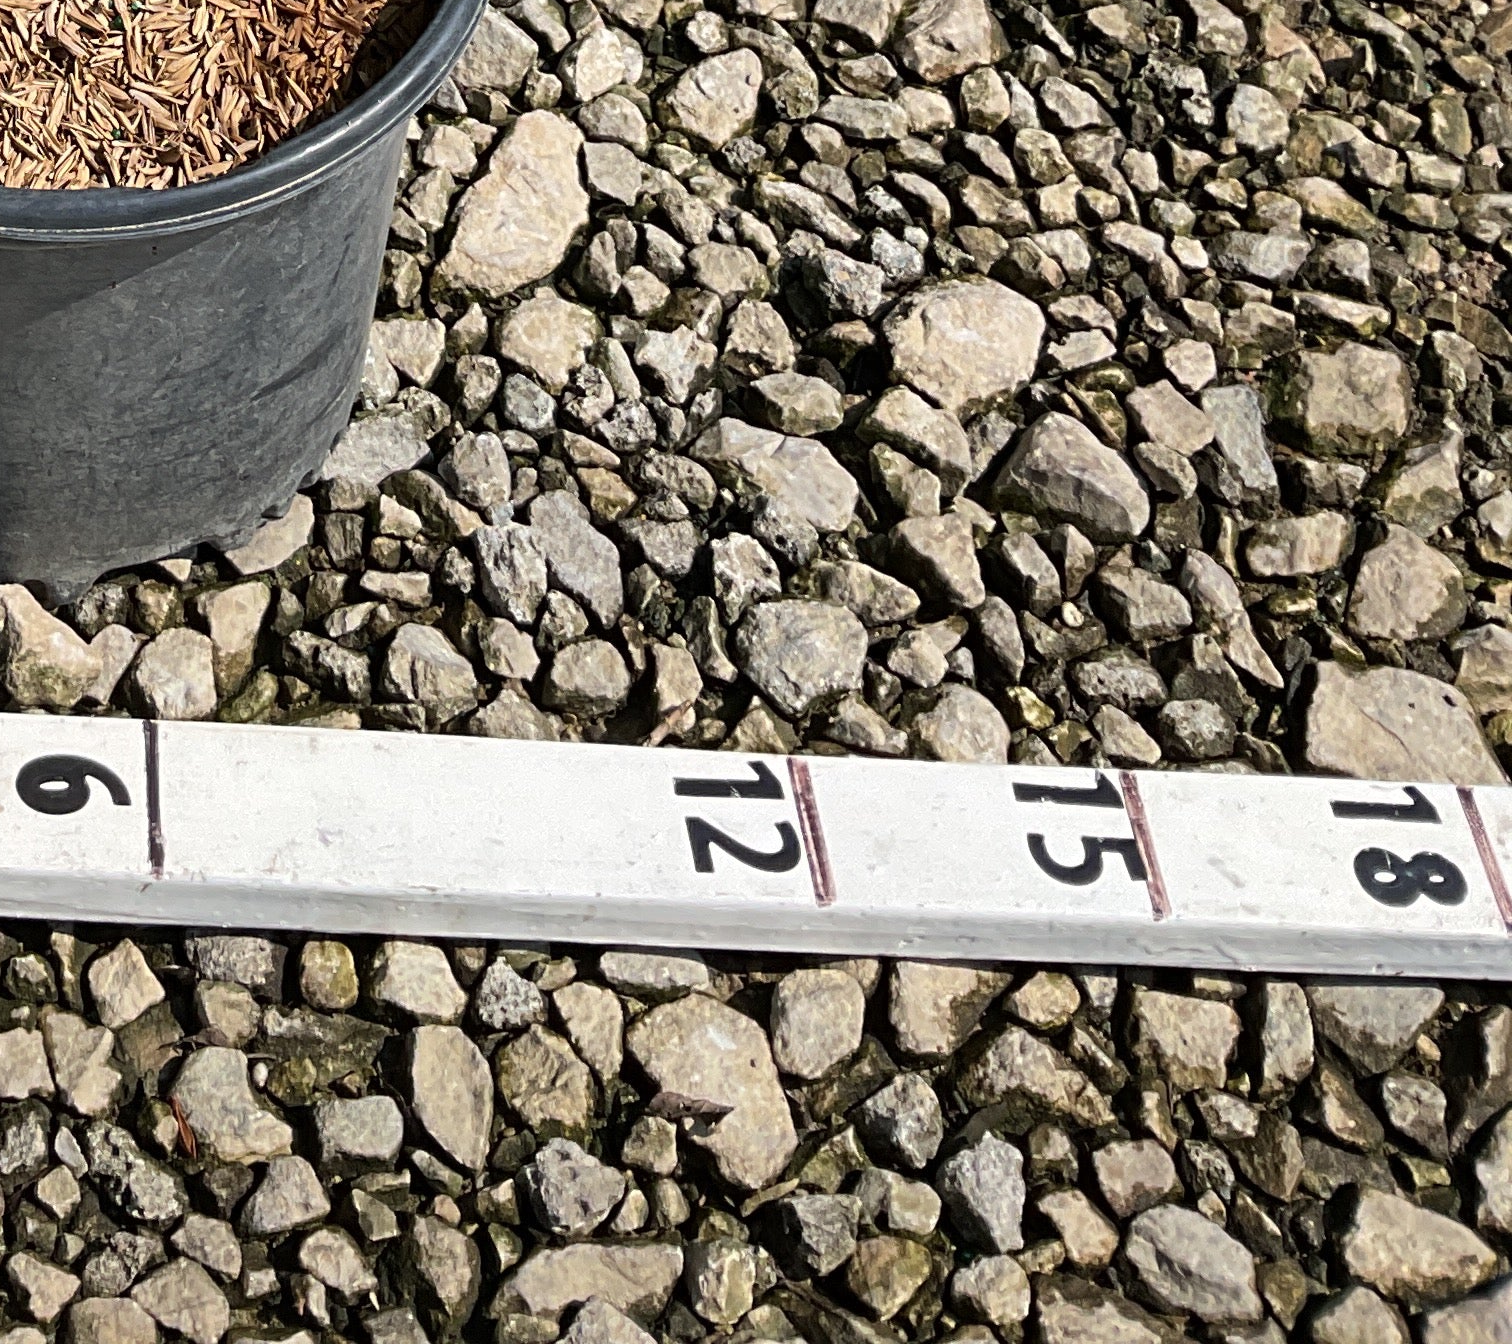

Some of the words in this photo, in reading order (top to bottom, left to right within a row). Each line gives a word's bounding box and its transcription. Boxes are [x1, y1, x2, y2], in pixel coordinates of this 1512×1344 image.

[15, 754, 131, 815] 6
[673, 761, 802, 873] 12
[1012, 769, 1149, 886] 15
[1329, 785, 1469, 908] 18
